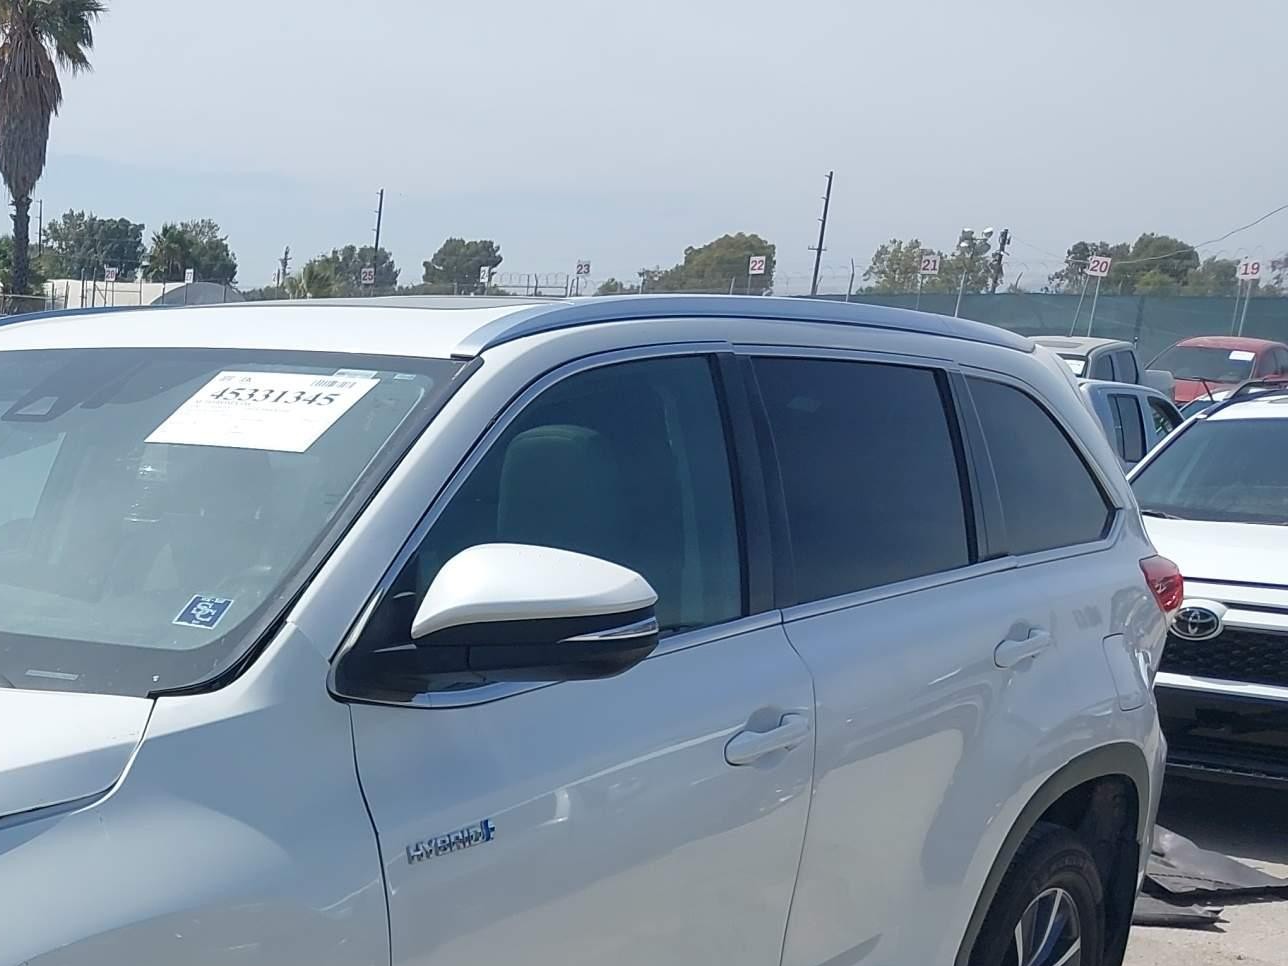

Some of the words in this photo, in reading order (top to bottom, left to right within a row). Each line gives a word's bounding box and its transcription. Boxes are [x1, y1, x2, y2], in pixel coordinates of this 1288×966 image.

[576, 263, 591, 274] 23
[751, 260, 764, 271] 22
[921, 259, 937, 271] 21
[1090, 259, 1109, 273] 20
[1242, 262, 1260, 276] 19
[362, 270, 373, 280] 25
[210, 386, 341, 406] 45331345
[406, 824, 487, 865] HYBRID
